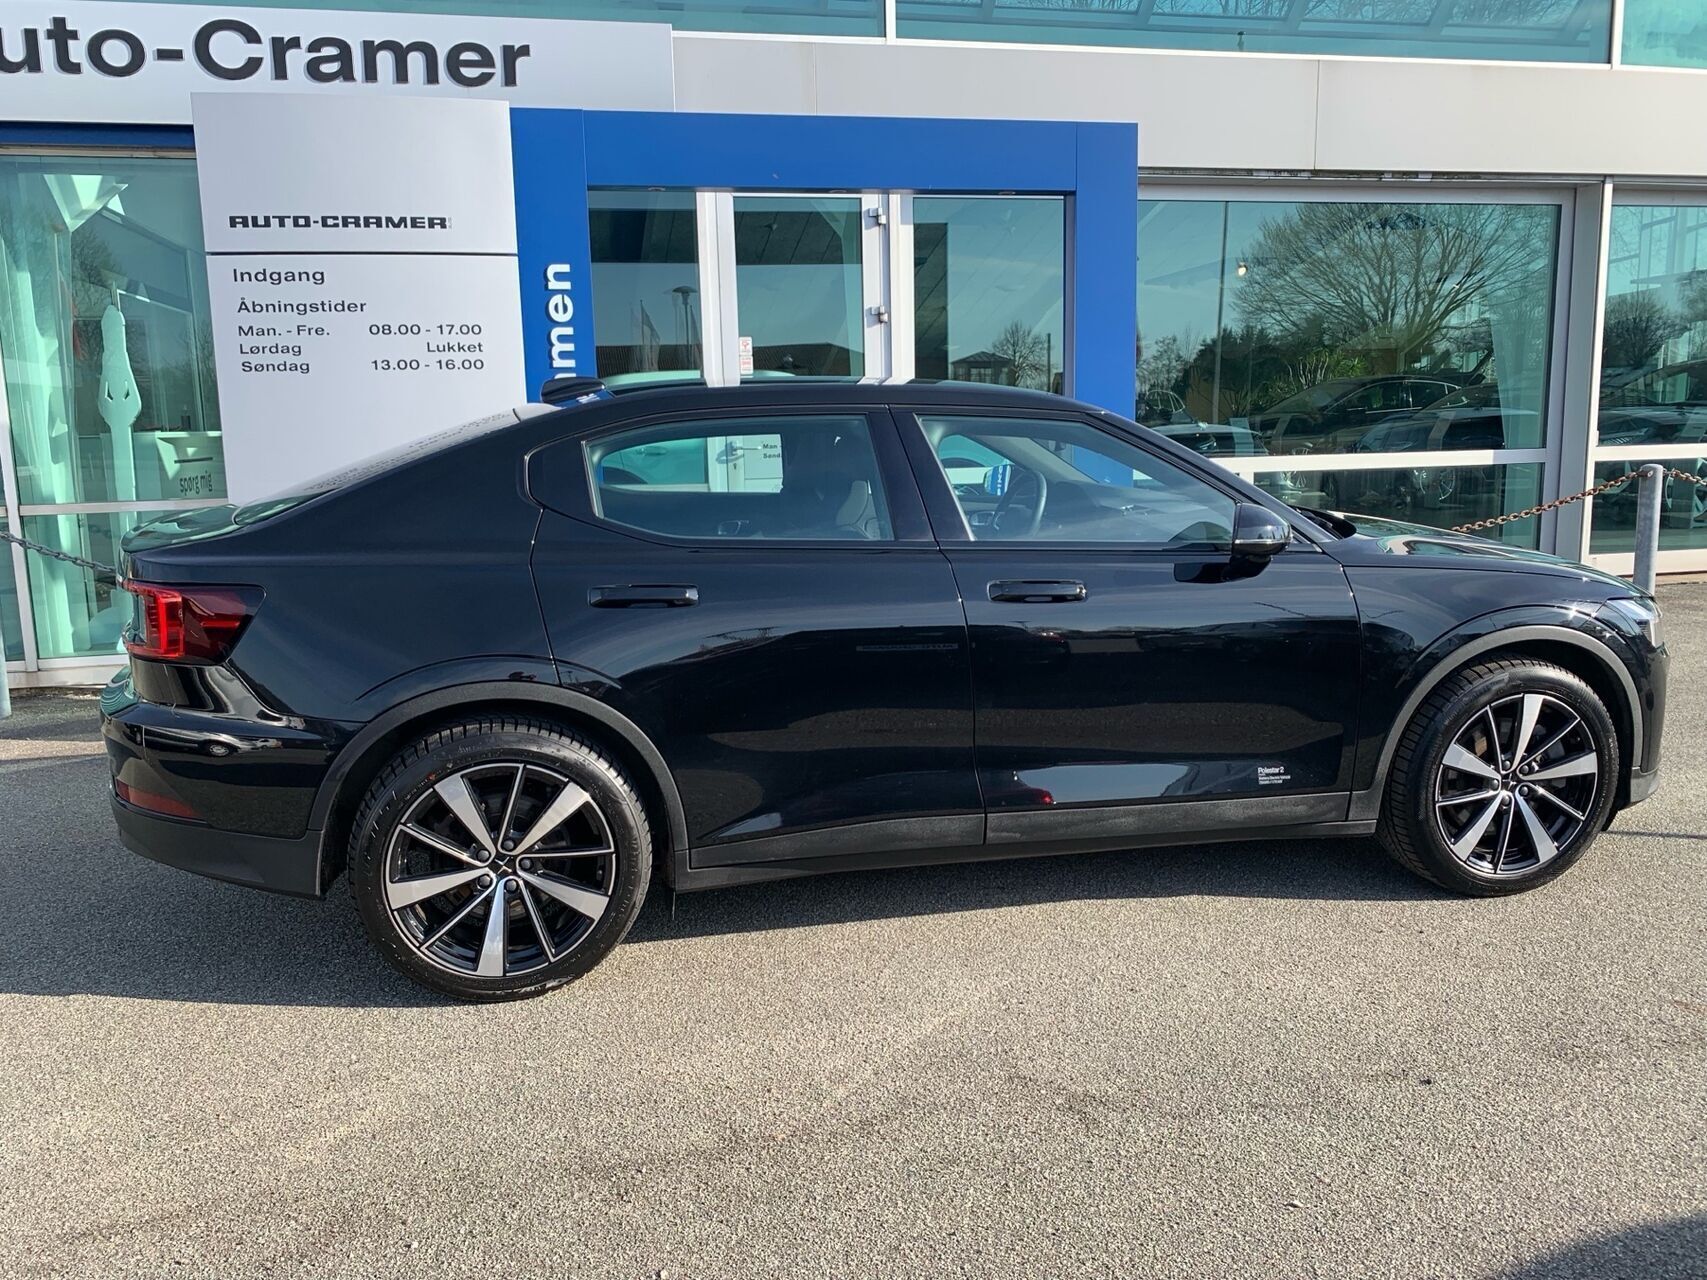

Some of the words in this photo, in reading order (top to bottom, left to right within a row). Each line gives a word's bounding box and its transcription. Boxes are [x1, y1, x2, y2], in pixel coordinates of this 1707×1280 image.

[228, 215, 447, 229] AUTO-CRAMER
[233, 268, 325, 286] Indgang
[237, 296, 367, 316] Åbningstider
[238, 325, 282, 337] Man.
[296, 324, 330, 336] Fre.
[368, 323, 421, 336] 08.00
[436, 323, 482, 336] 17.00
[239, 343, 302, 357] Lørdag
[426, 341, 484, 353] Lukket
[241, 361, 310, 375] Søndag
[371, 359, 420, 371] 13.00
[436, 358, 484, 371] 16.00
